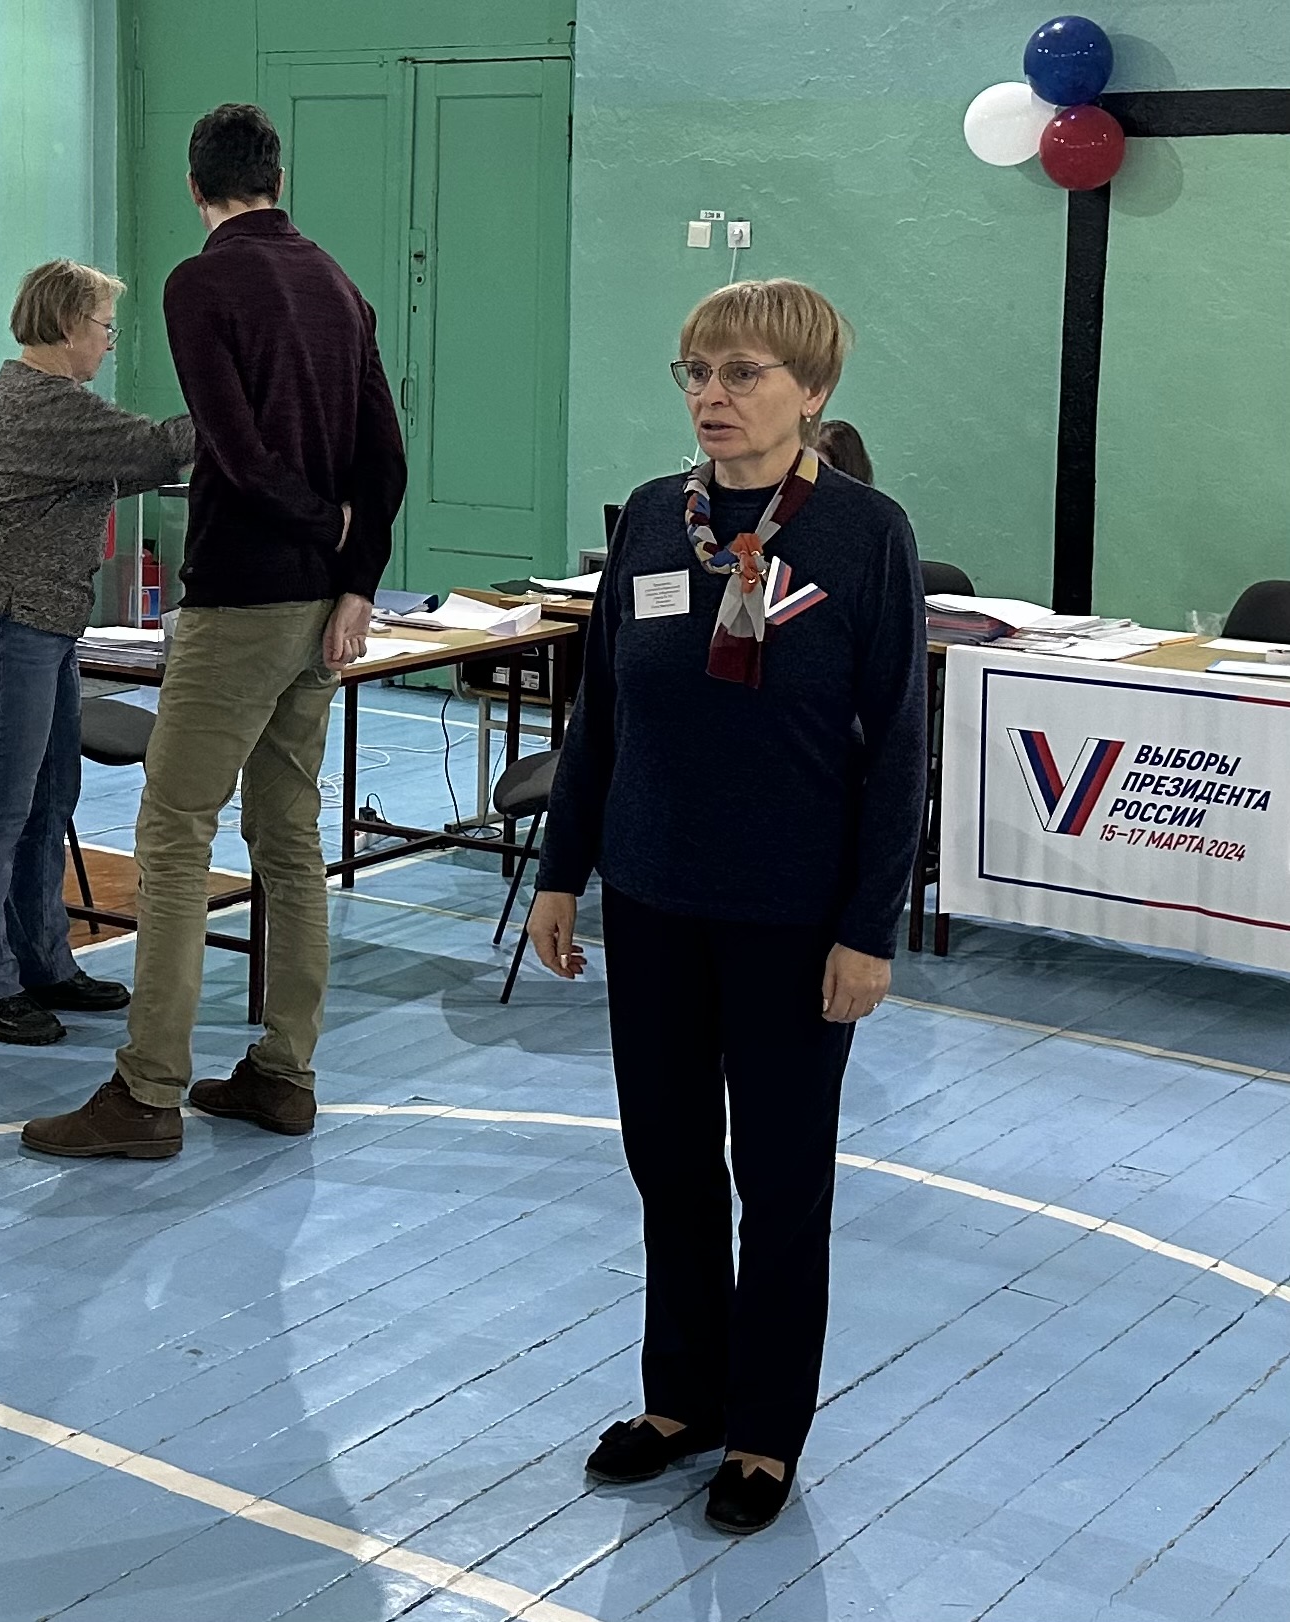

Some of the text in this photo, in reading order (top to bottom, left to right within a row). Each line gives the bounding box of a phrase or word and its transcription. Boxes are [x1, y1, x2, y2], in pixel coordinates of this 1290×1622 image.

[1133, 743, 1242, 777] ВЫБОРЫ
[1120, 770, 1272, 812] ПРЕЗИДЕНТА
[1108, 797, 1207, 829] РОССИИ
[1145, 829, 1205, 855] МАРТА
[1205, 839, 1247, 862] 2024
